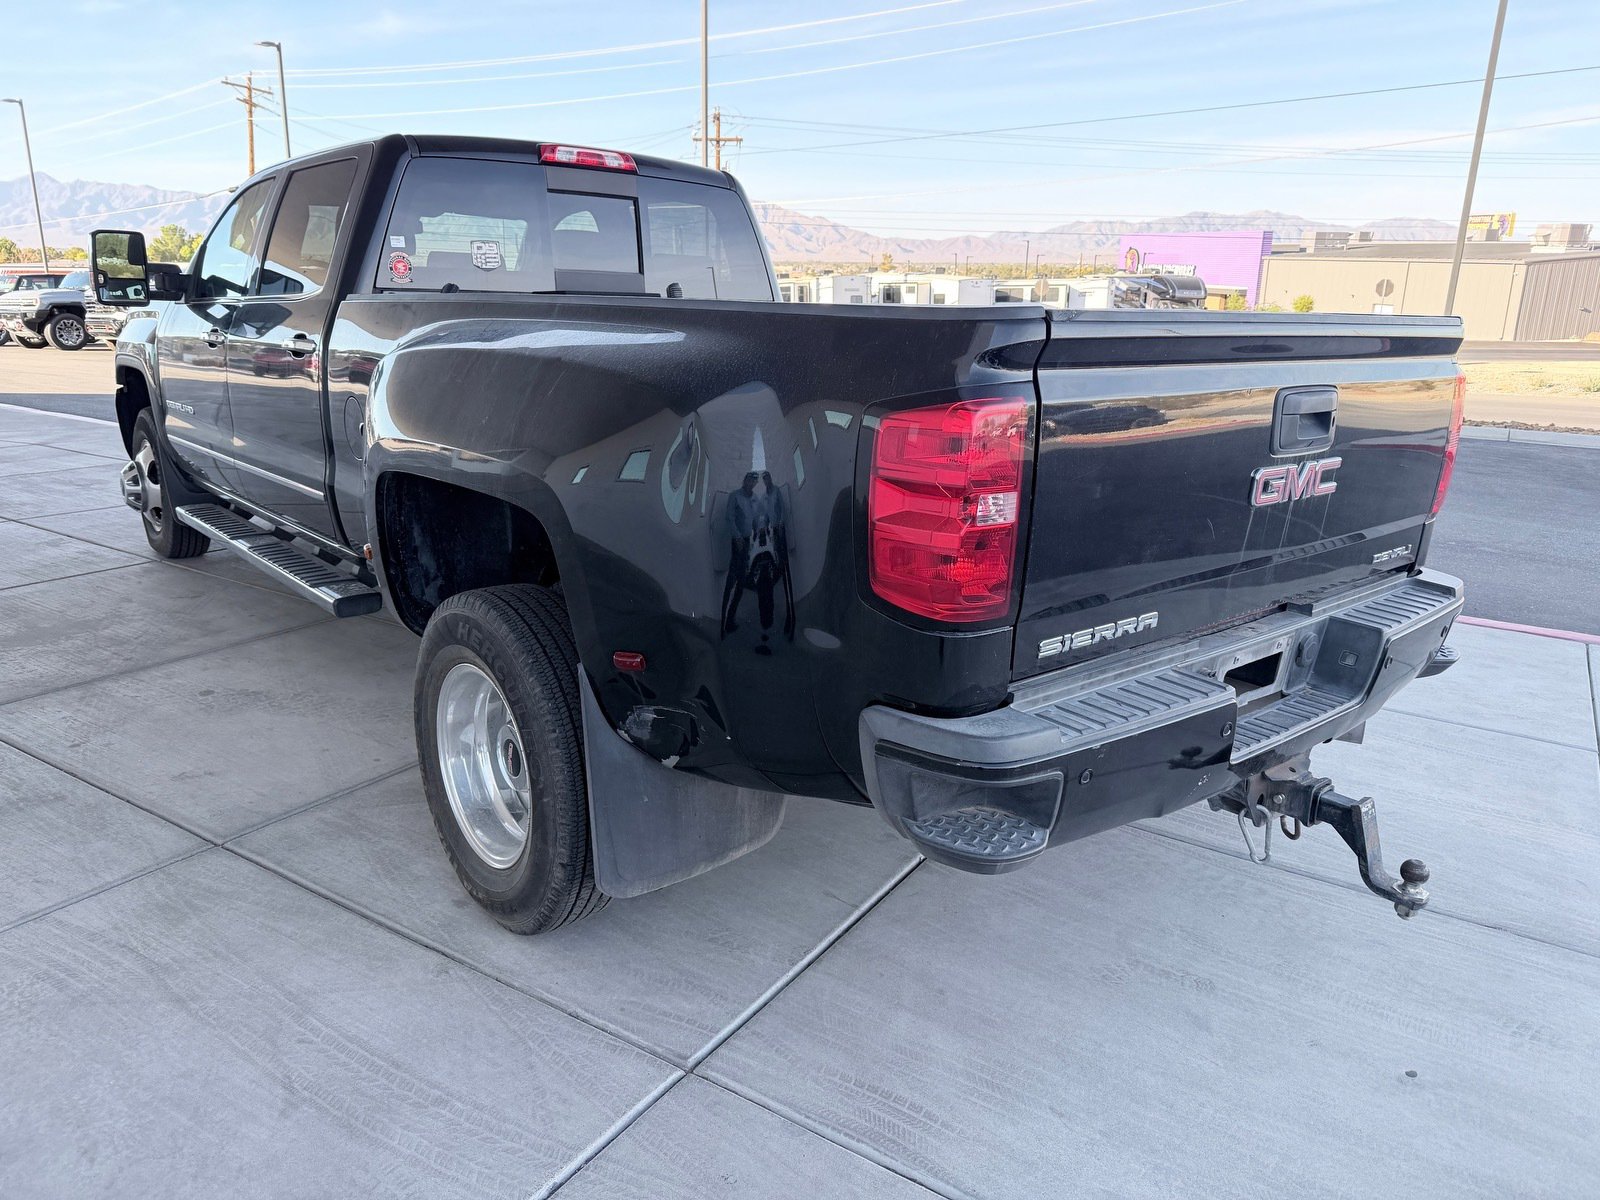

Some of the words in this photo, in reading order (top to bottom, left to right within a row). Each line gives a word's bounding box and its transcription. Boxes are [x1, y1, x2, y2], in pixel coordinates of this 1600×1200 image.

[1250, 457, 1342, 506] GMC
[1372, 544, 1412, 564] DENALI
[1038, 611, 1159, 659] SIERRA
